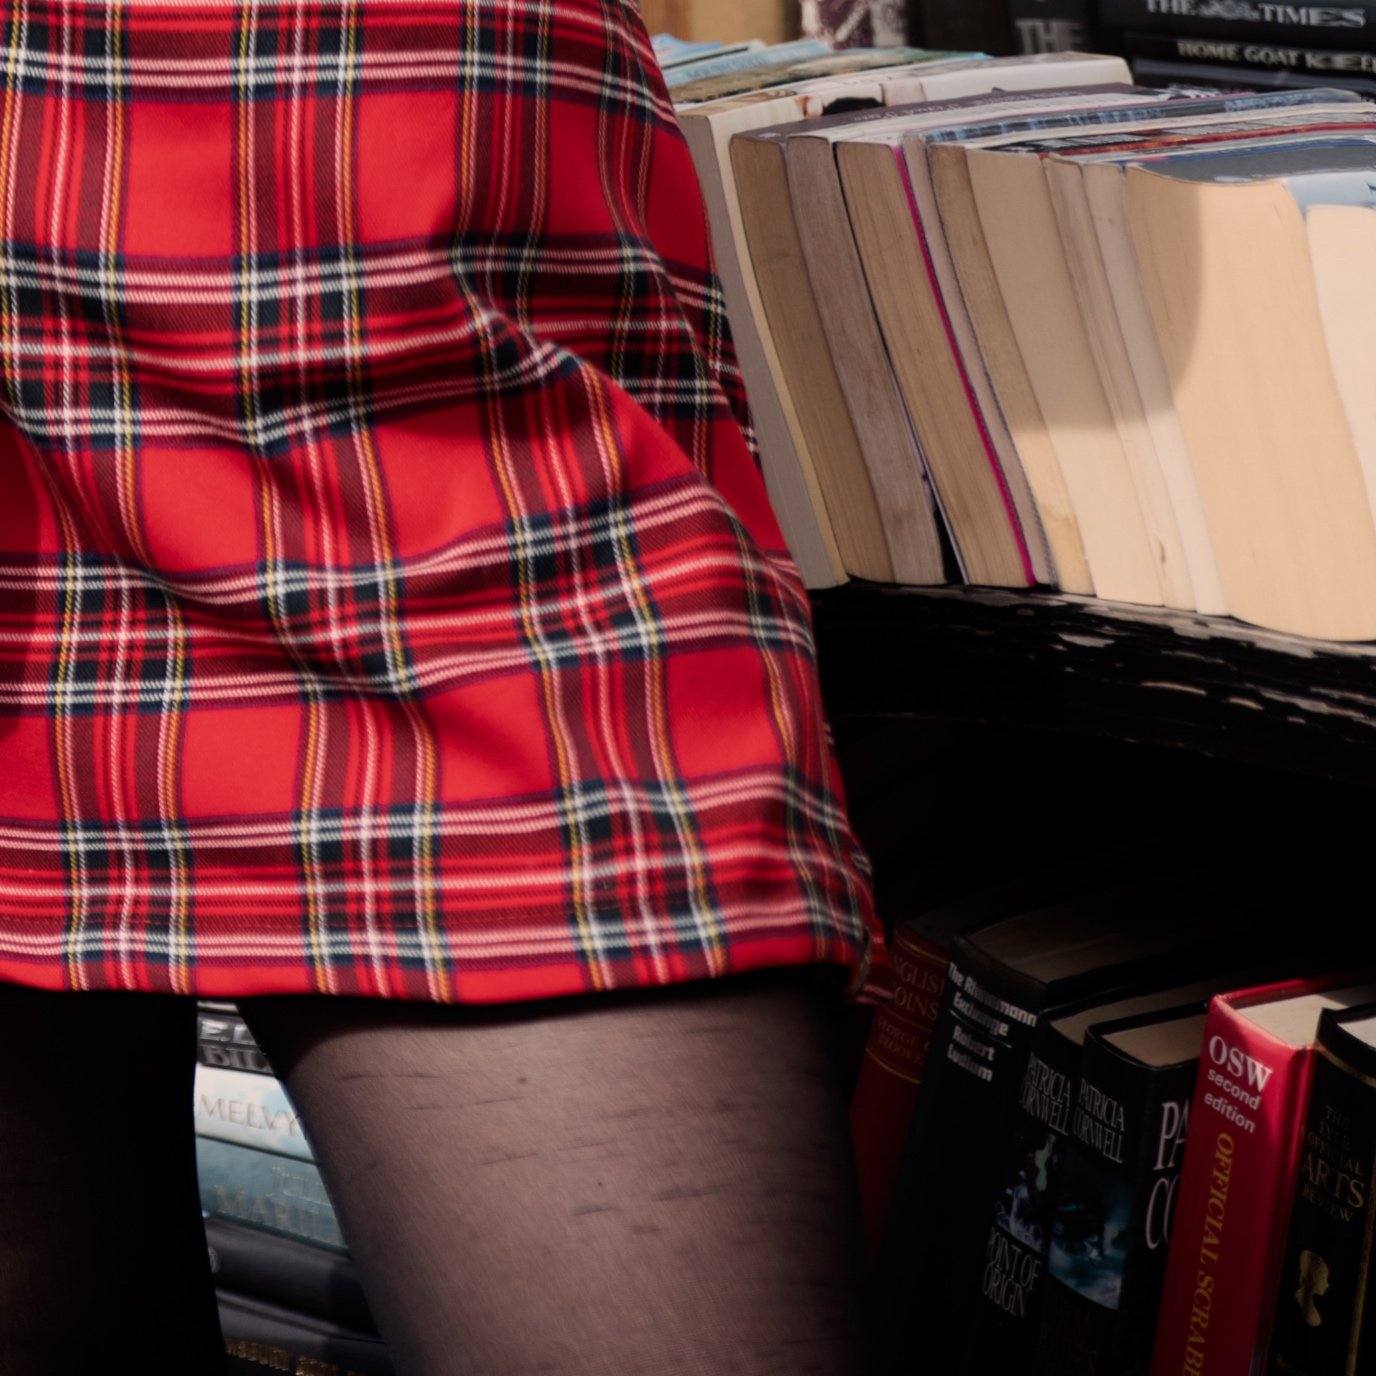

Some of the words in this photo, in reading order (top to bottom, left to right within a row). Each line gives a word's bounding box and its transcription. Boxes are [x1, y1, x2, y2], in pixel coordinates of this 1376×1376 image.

[1256, 1, 1368, 30] TIMES
[1243, 45, 1301, 66] GOAT
[1209, 1034, 1274, 1094] OSW
[1206, 1066, 1261, 1111] second
[1203, 1090, 1257, 1135] edition
[1200, 1131, 1236, 1267] OFFICIAL
